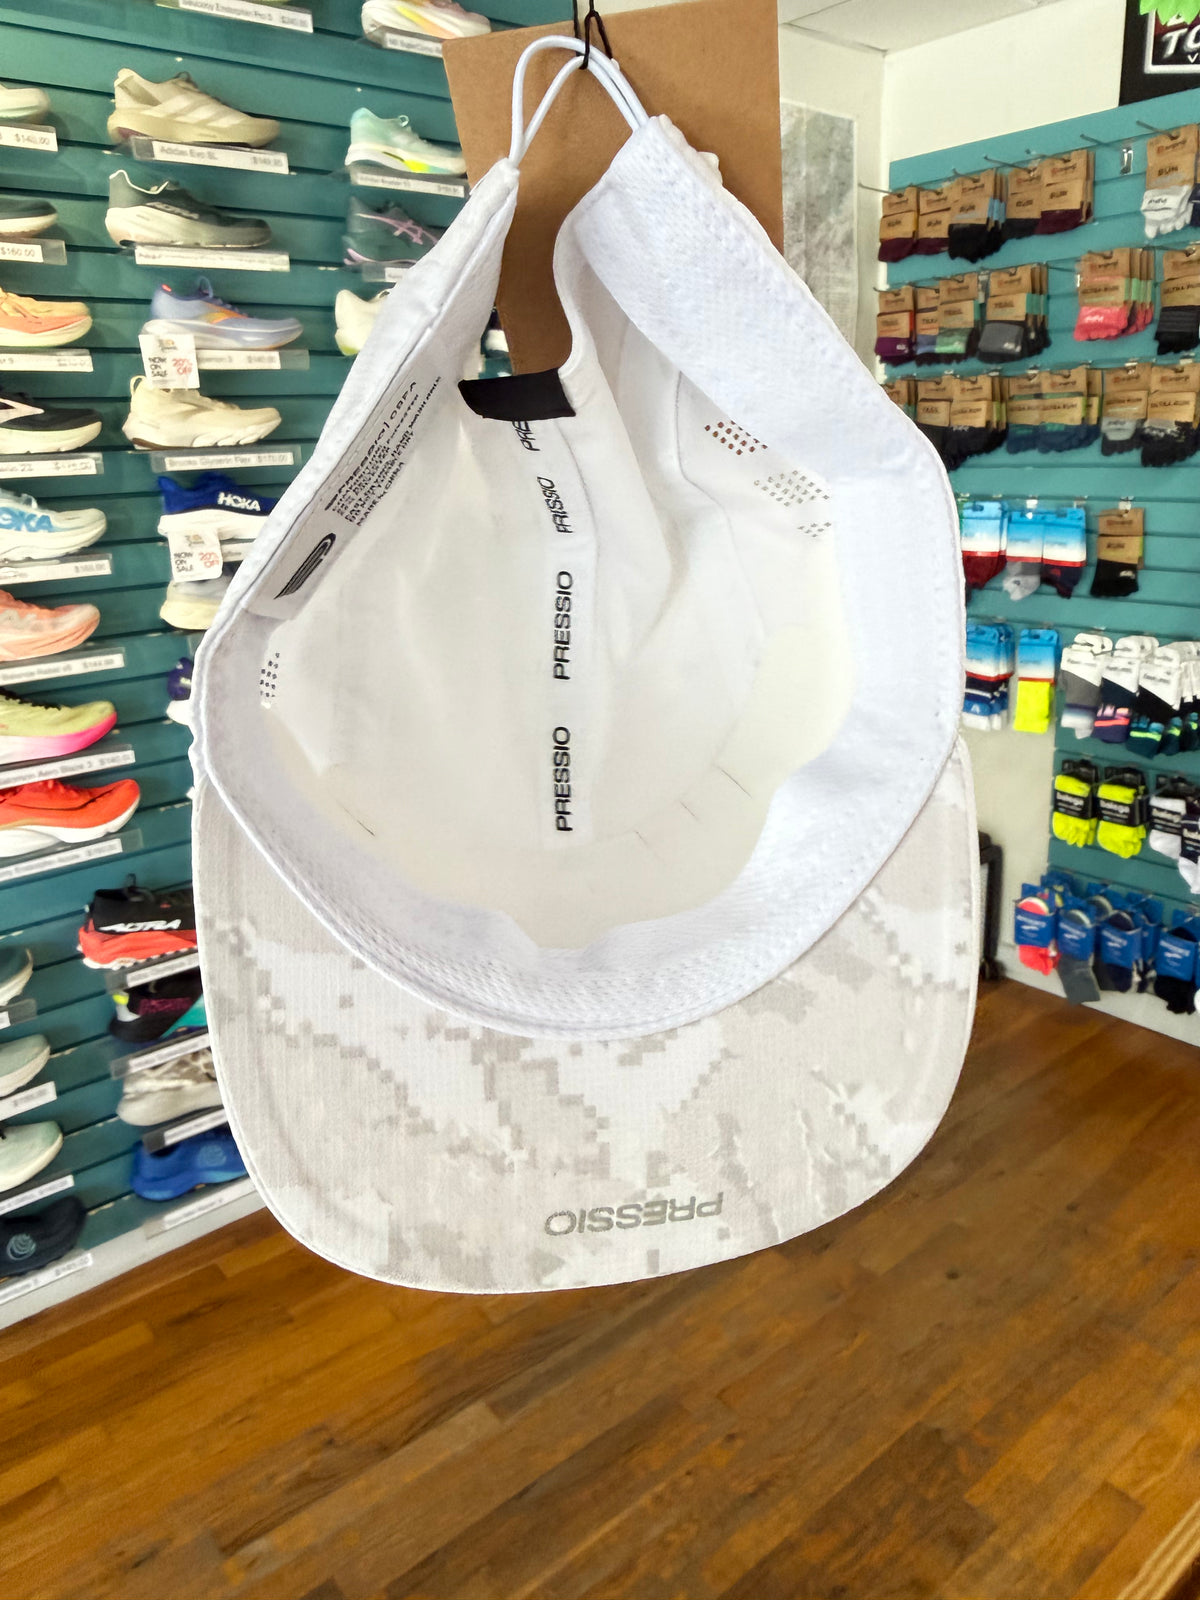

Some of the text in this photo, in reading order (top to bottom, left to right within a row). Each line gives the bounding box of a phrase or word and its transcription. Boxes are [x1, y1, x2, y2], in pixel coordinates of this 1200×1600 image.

[217, 491, 261, 512] HOKA
[0, 506, 54, 533] OKA
[174, 551, 193, 559] NOW
[553, 570, 573, 680] PRESSIO
[552, 726, 573, 832] PRESSIO
[98, 918, 181, 933] ALTRA
[545, 1191, 723, 1236] PRESSIO
